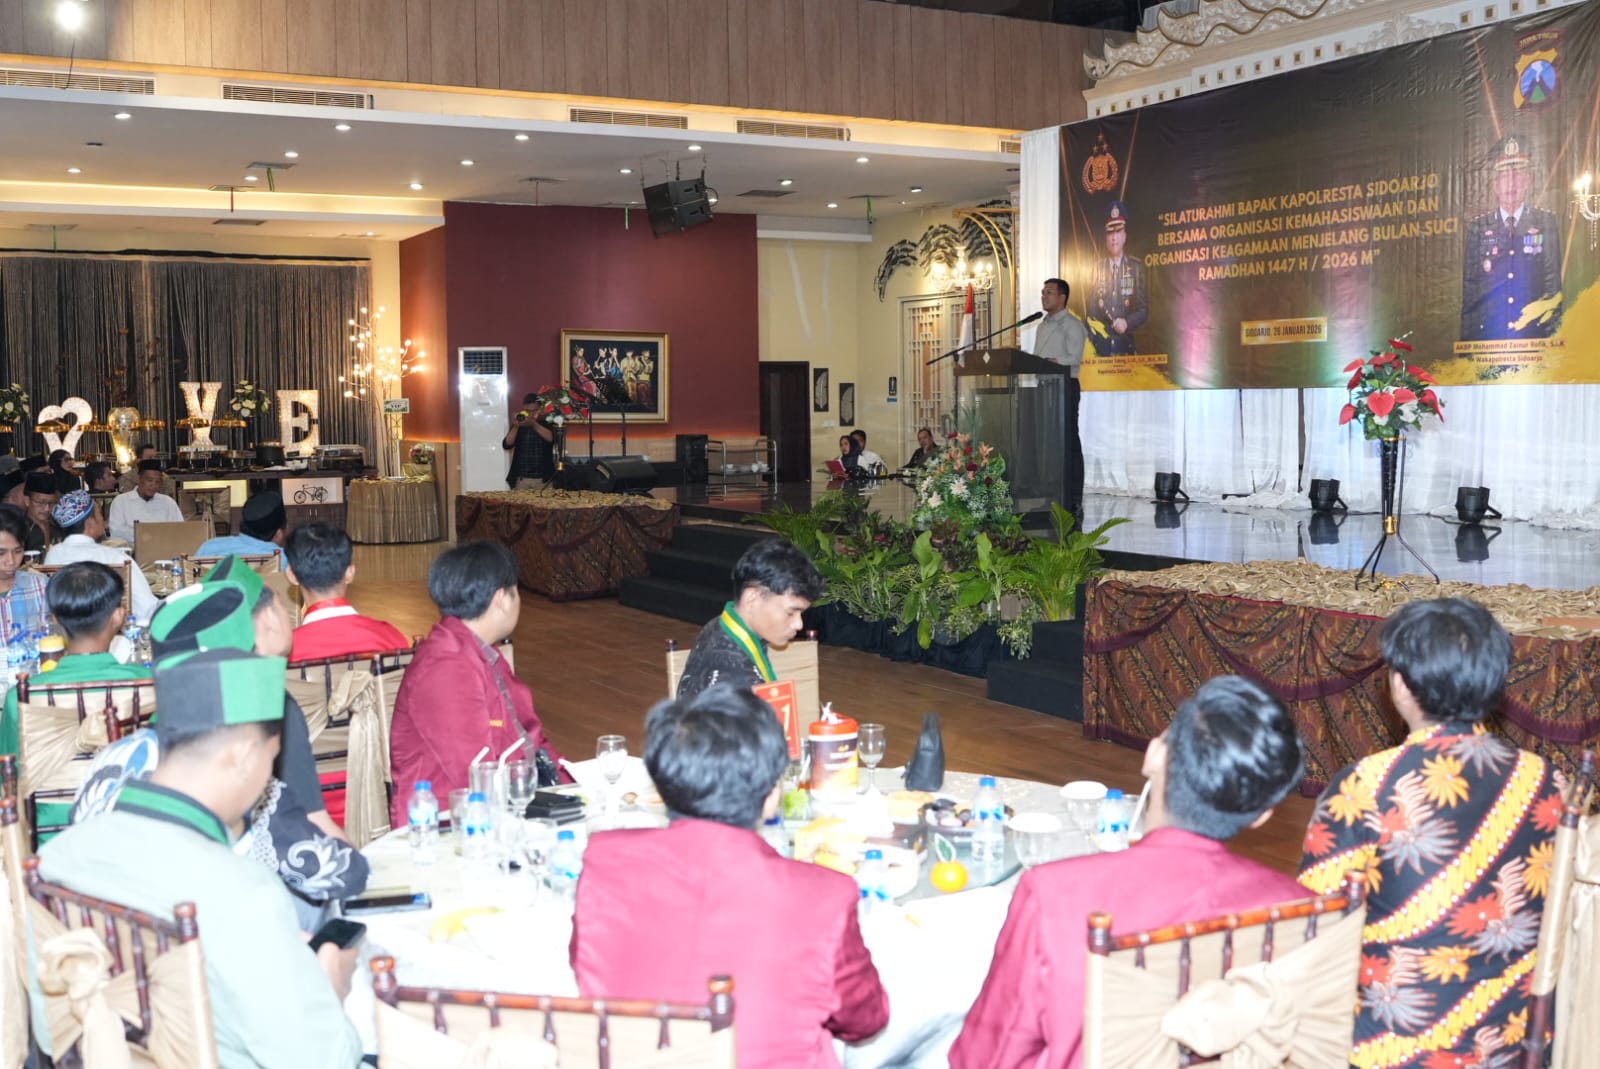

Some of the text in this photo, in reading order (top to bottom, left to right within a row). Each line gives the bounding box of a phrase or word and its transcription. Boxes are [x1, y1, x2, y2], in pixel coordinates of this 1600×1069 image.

[1237, 197, 1278, 214] BAPAK
[1280, 184, 1363, 208] KAPOLRESTA
[1366, 173, 1440, 198] SIDOARJO
[1157, 195, 1440, 247] BERSAMA ORGANISASI KEMAHASISWAAN DAN
[1144, 216, 1459, 268] ORGANISASI KEAGAMAAN MENJELANG BULAN SUCI
[1198, 259, 1266, 281] RAMADHAN
[1268, 257, 1297, 274] 1447
[1298, 255, 1309, 271] H
[1311, 255, 1319, 271] /
[1322, 250, 1359, 270] 2026
[1282, 325, 1306, 337] JANUARI
[1307, 323, 1322, 335] 2026
